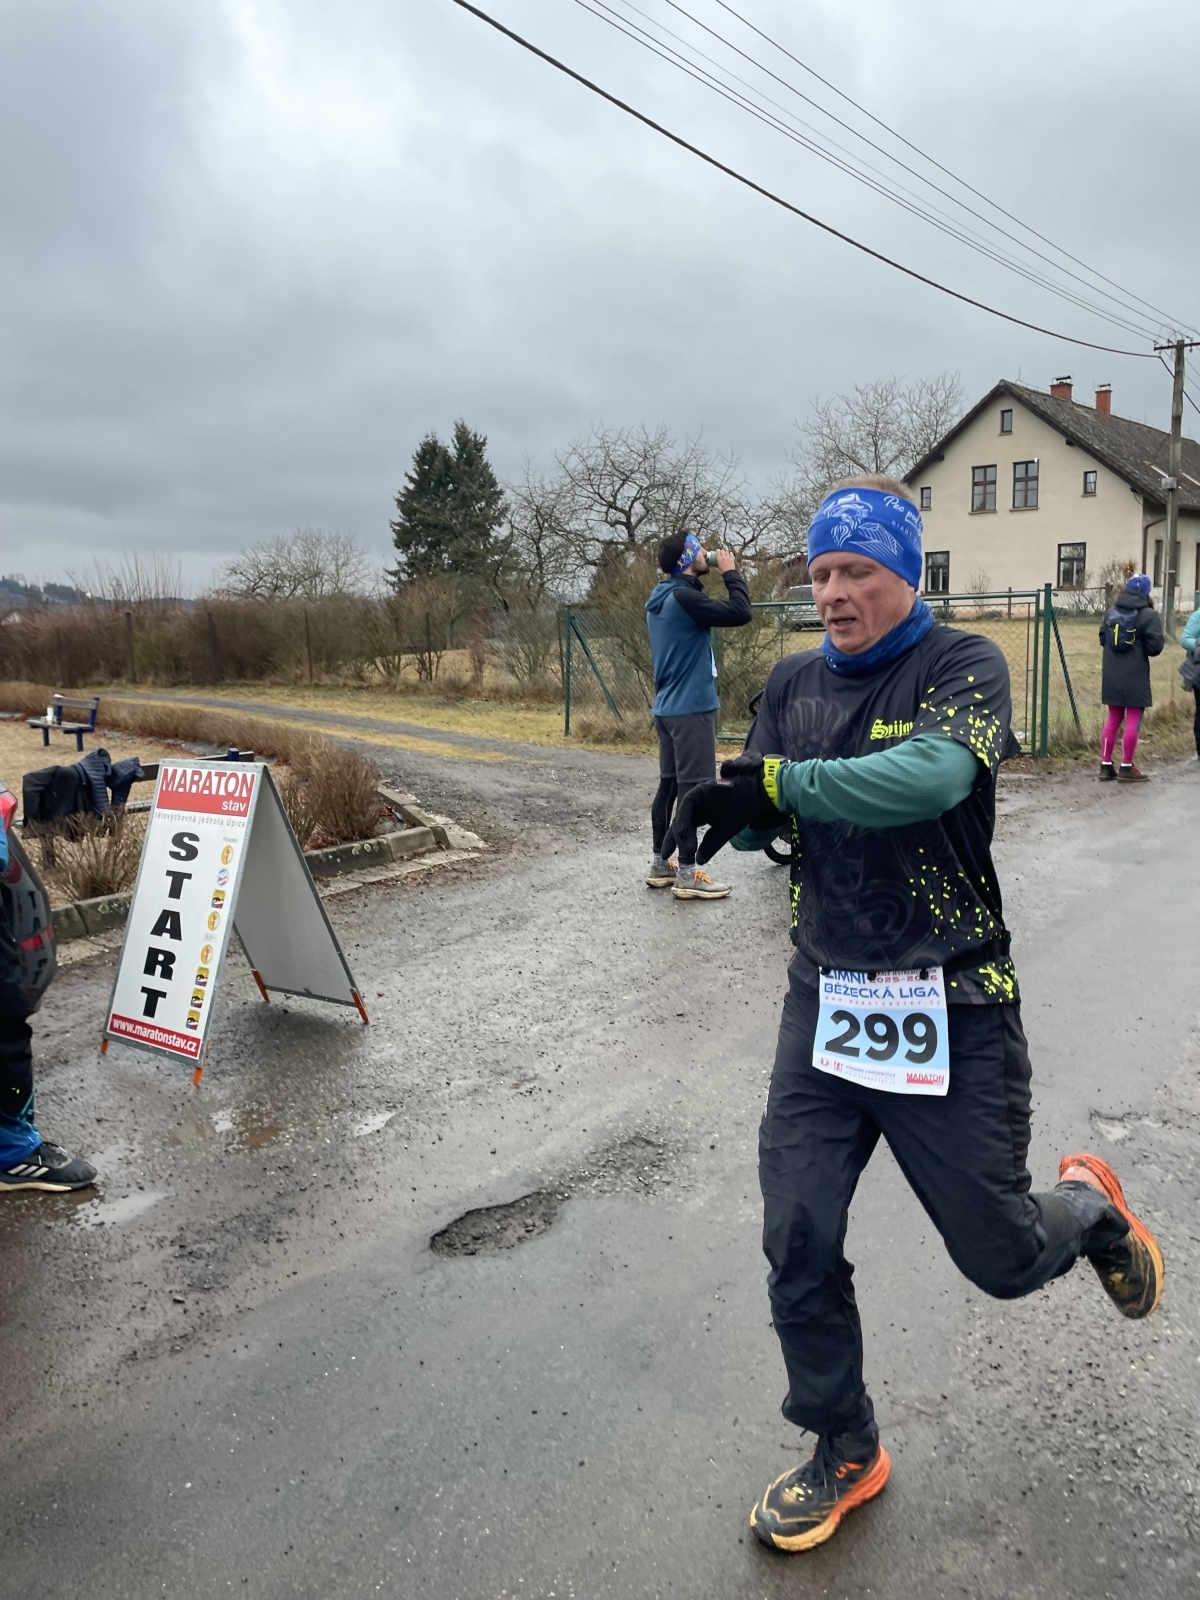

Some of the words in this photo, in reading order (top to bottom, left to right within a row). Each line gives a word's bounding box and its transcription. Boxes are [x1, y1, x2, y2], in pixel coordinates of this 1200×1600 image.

[160, 768, 256, 798] MARATON
[221, 799, 247, 812] stav
[198, 816, 224, 826] jednota
[140, 831, 200, 1019] START
[899, 985, 940, 999] LIGA
[112, 1018, 198, 1053] www.maratonstav.cz
[824, 1009, 938, 1065] 299
